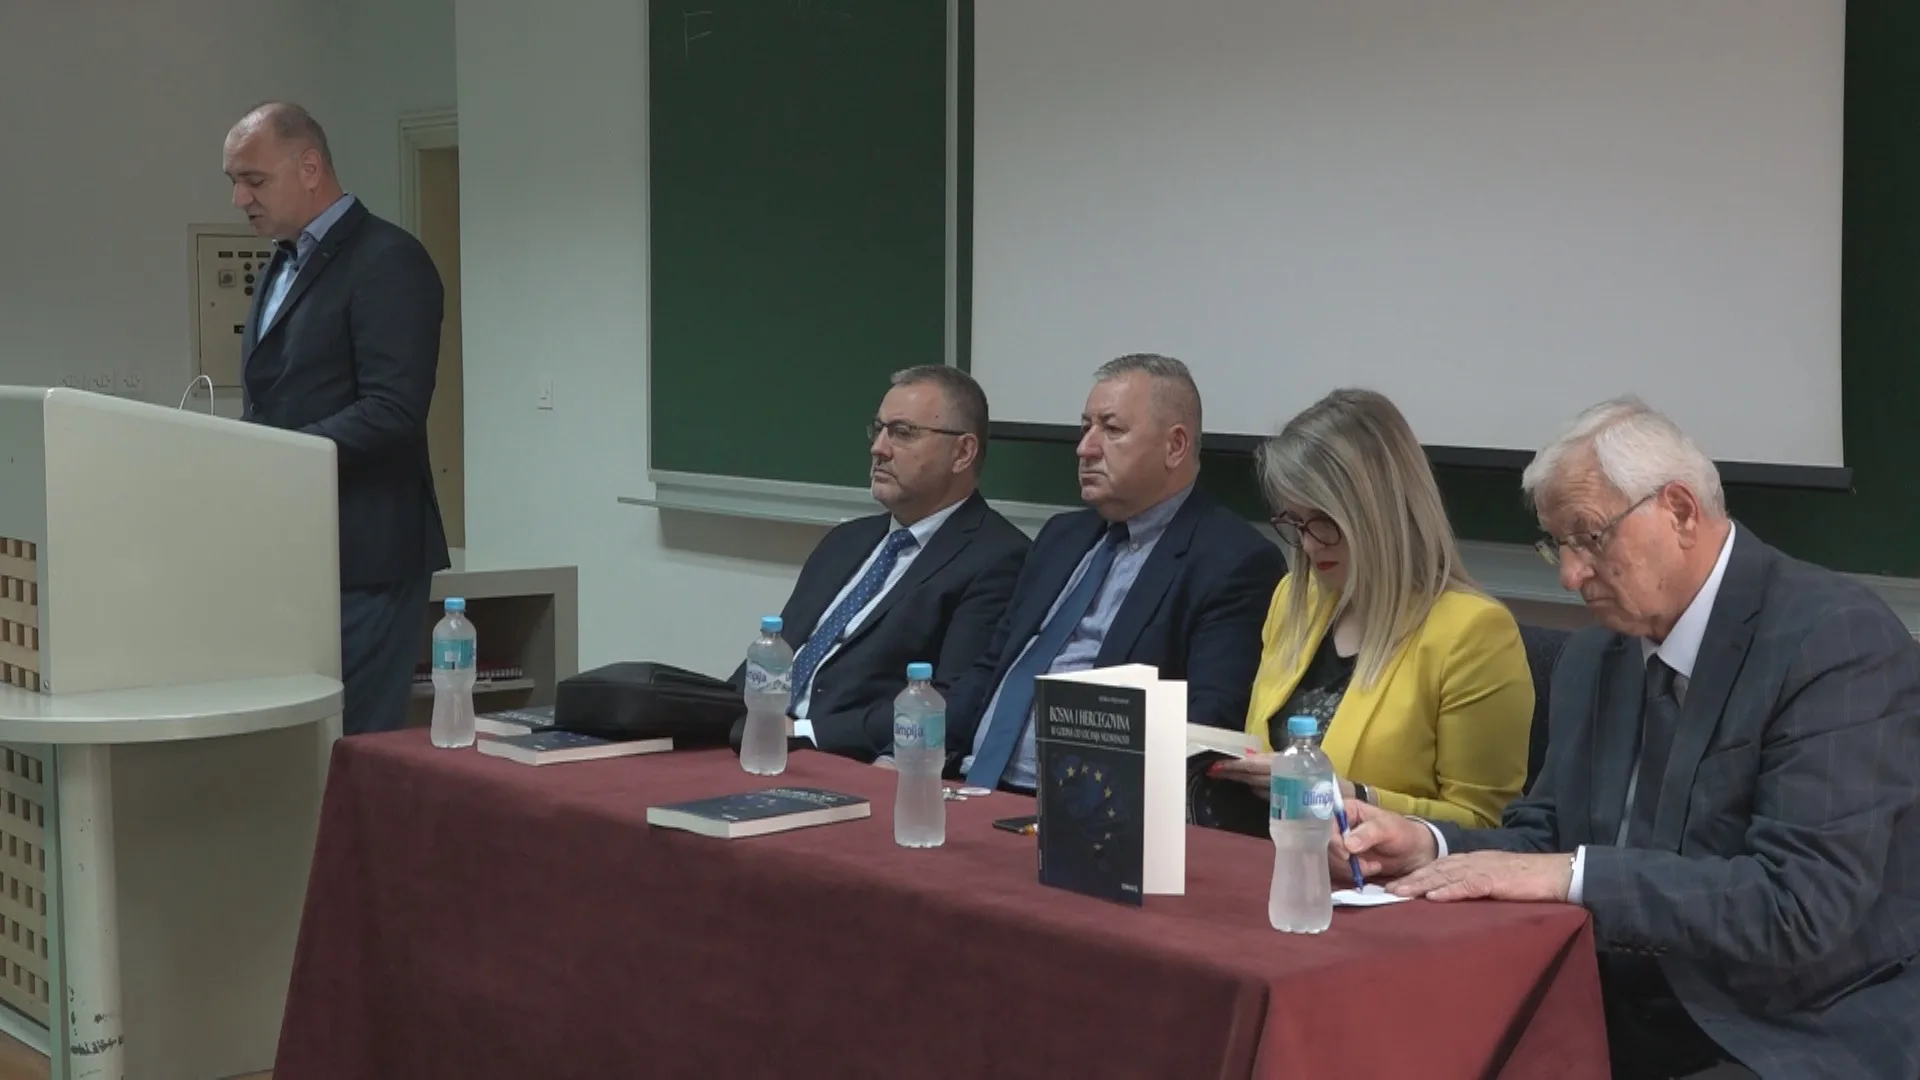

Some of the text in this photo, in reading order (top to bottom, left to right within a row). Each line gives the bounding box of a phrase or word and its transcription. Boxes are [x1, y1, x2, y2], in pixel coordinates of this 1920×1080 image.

[1049, 705, 1074, 724] BOSNA
[1075, 709, 1079, 724] I
[1079, 709, 1130, 731] HERCEGOVINA
